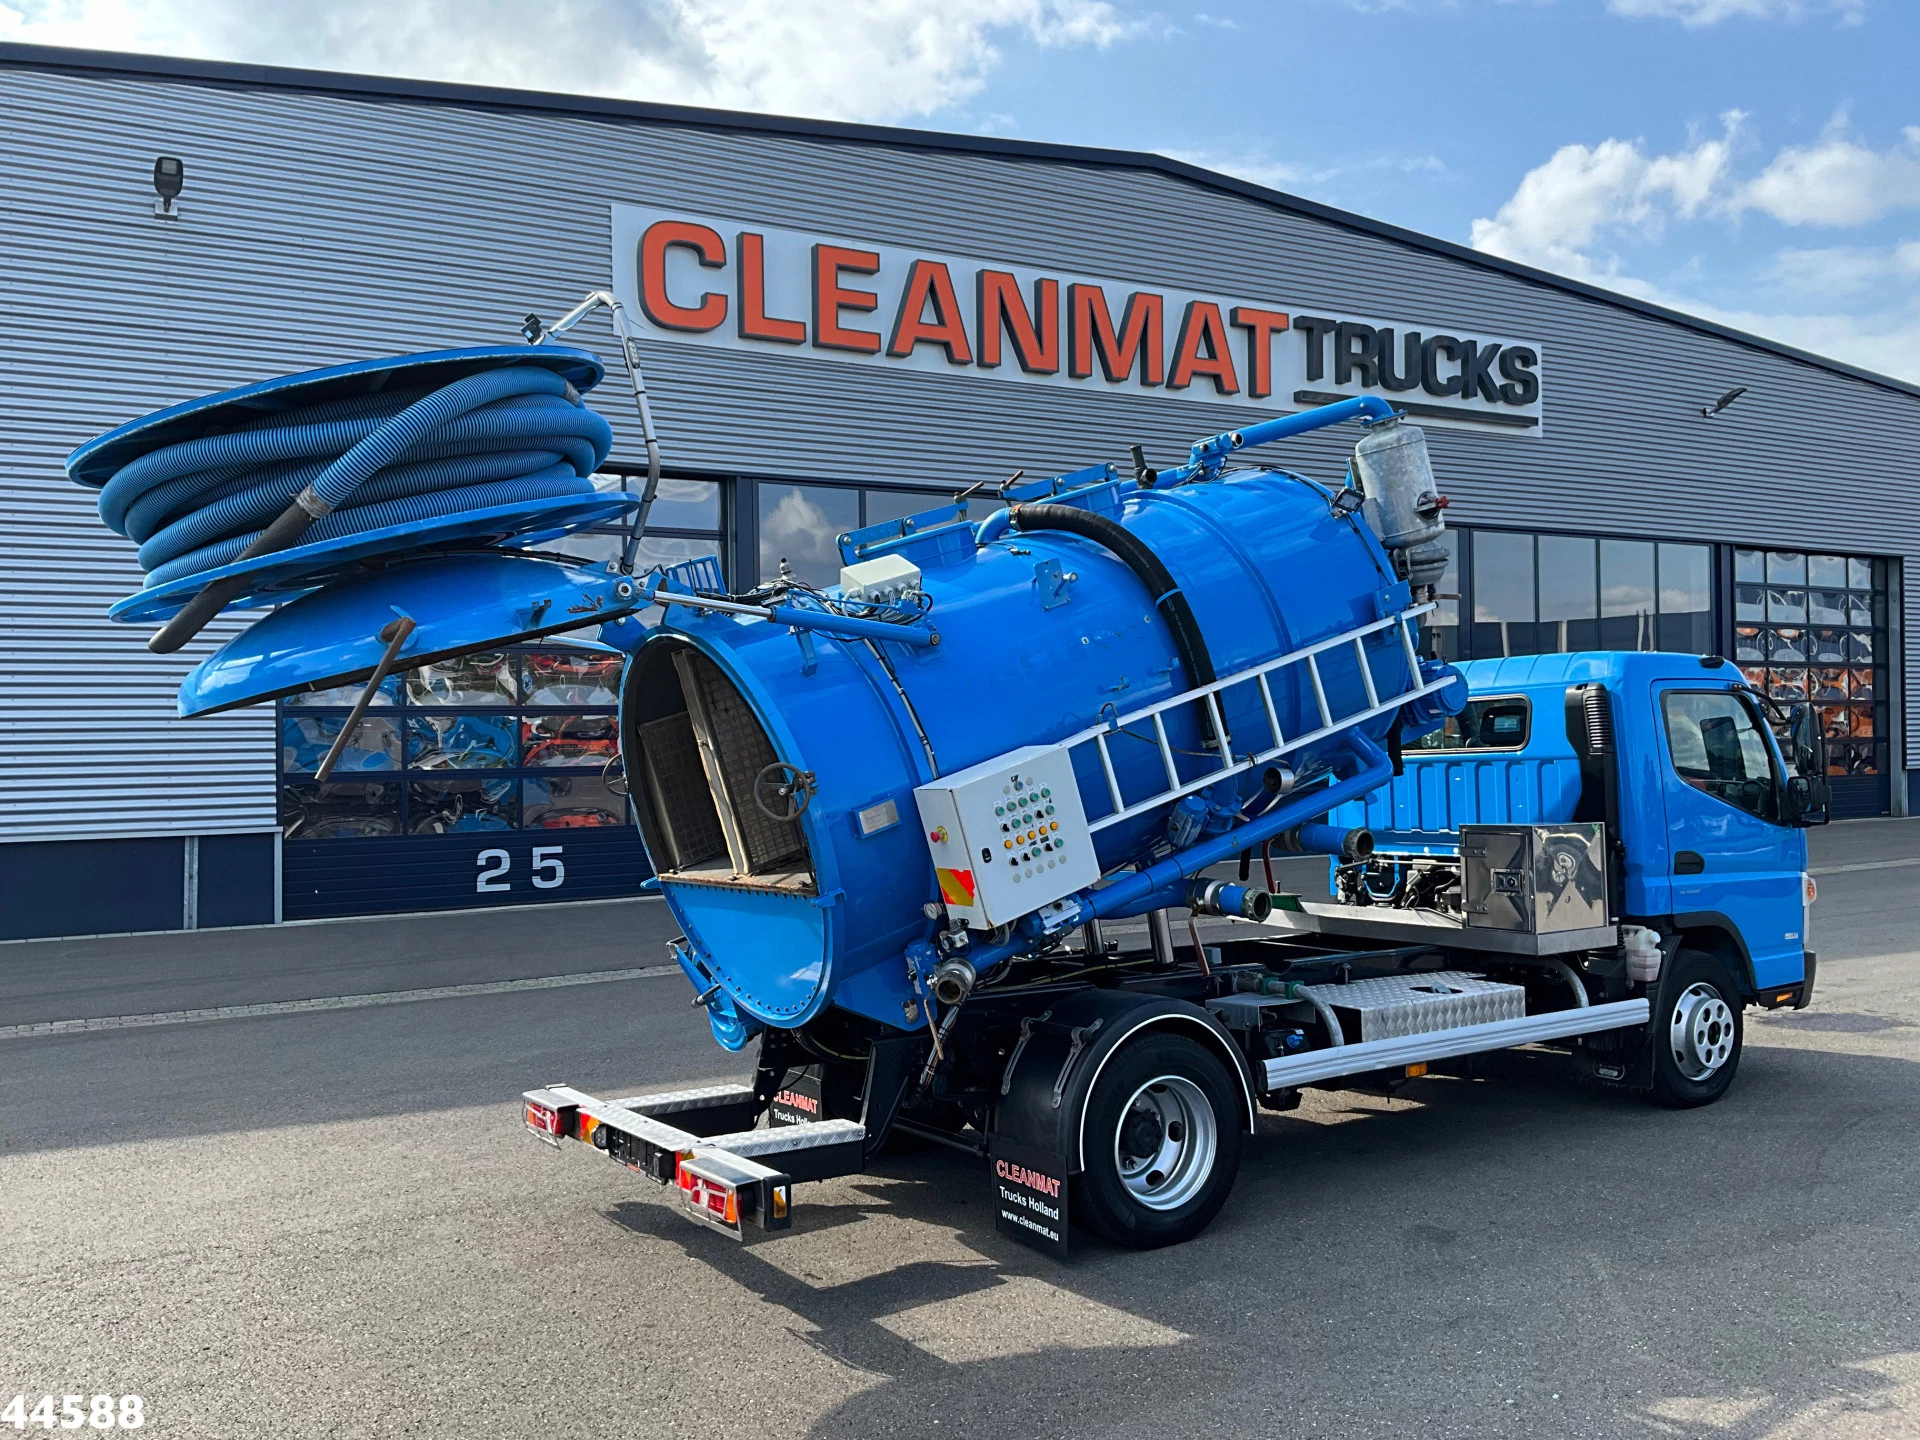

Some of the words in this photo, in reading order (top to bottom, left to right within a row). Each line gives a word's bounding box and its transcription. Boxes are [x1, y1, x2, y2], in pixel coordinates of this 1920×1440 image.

[636, 219, 1289, 398] CLEANMAT
[1293, 315, 1539, 405] TRUCKS
[773, 1108, 796, 1124] Trucks
[996, 1159, 1061, 1198] CLEANMAT
[999, 1185, 1027, 1207] Trucks
[1028, 1196, 1059, 1221] Holland
[1001, 1209, 1059, 1241] www.cleanmat.eu
